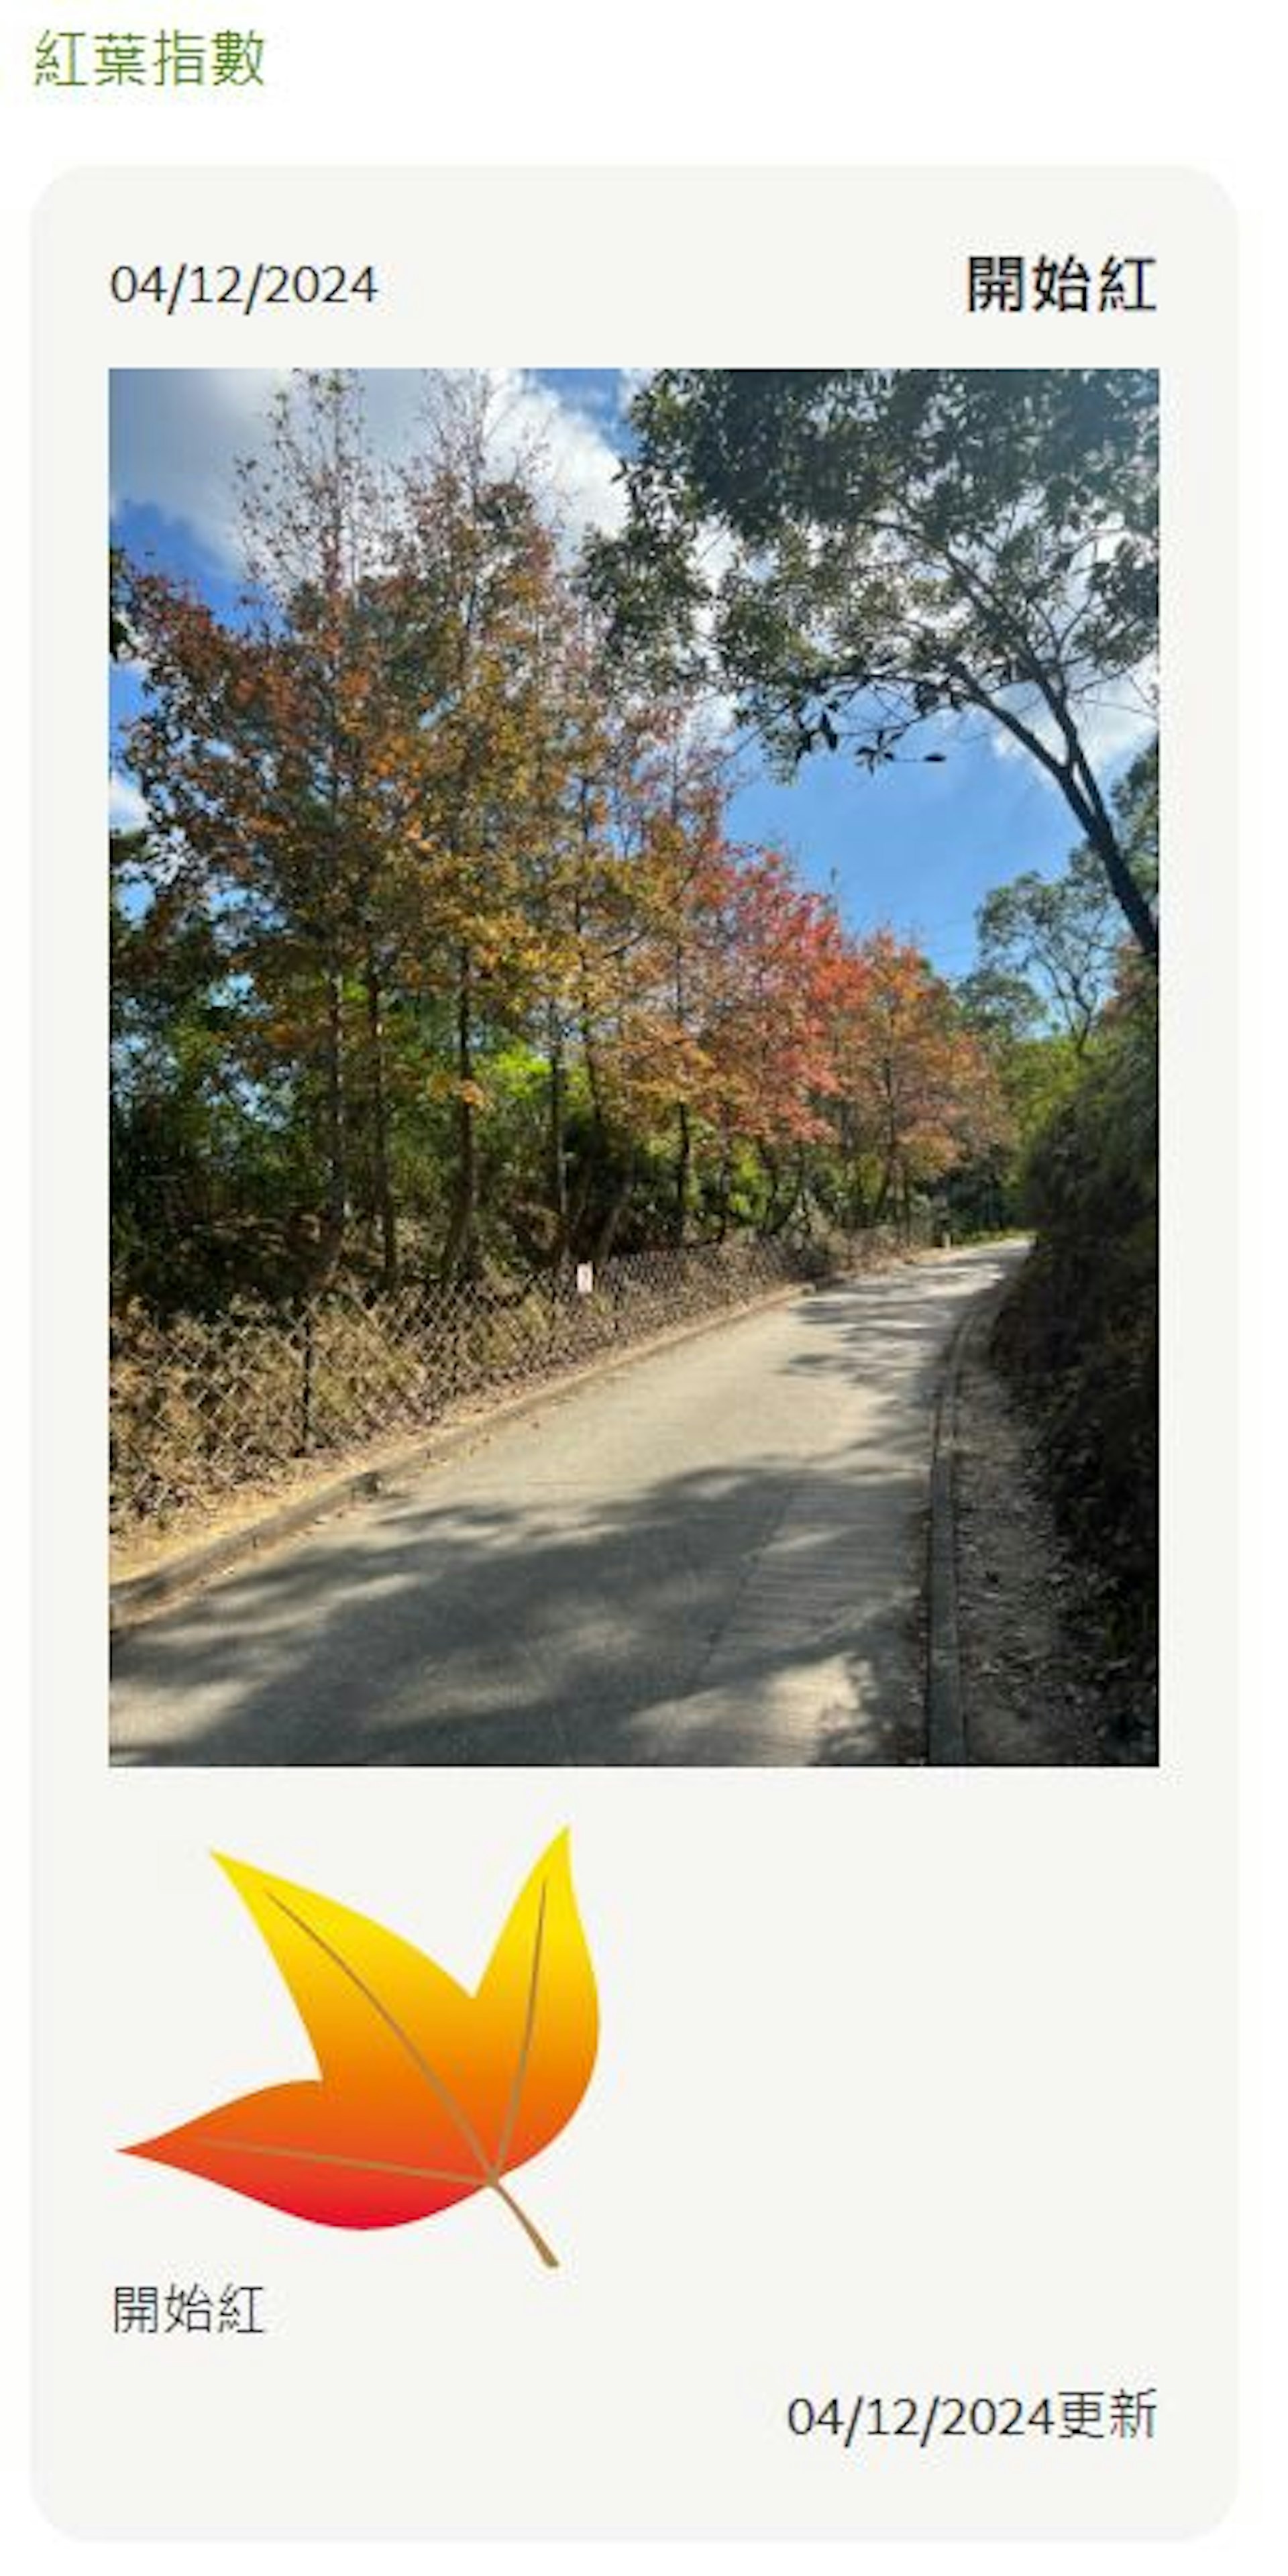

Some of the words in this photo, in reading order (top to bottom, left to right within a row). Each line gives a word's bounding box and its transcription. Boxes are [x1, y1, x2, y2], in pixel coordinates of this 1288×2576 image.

[34, 29, 264, 87] 紅葉指數
[109, 262, 380, 317] 04/12/2024
[967, 253, 1157, 313] 開始紅
[113, 2282, 266, 2335] 開始紅
[787, 2387, 1158, 2449] 04/12/2024更新
